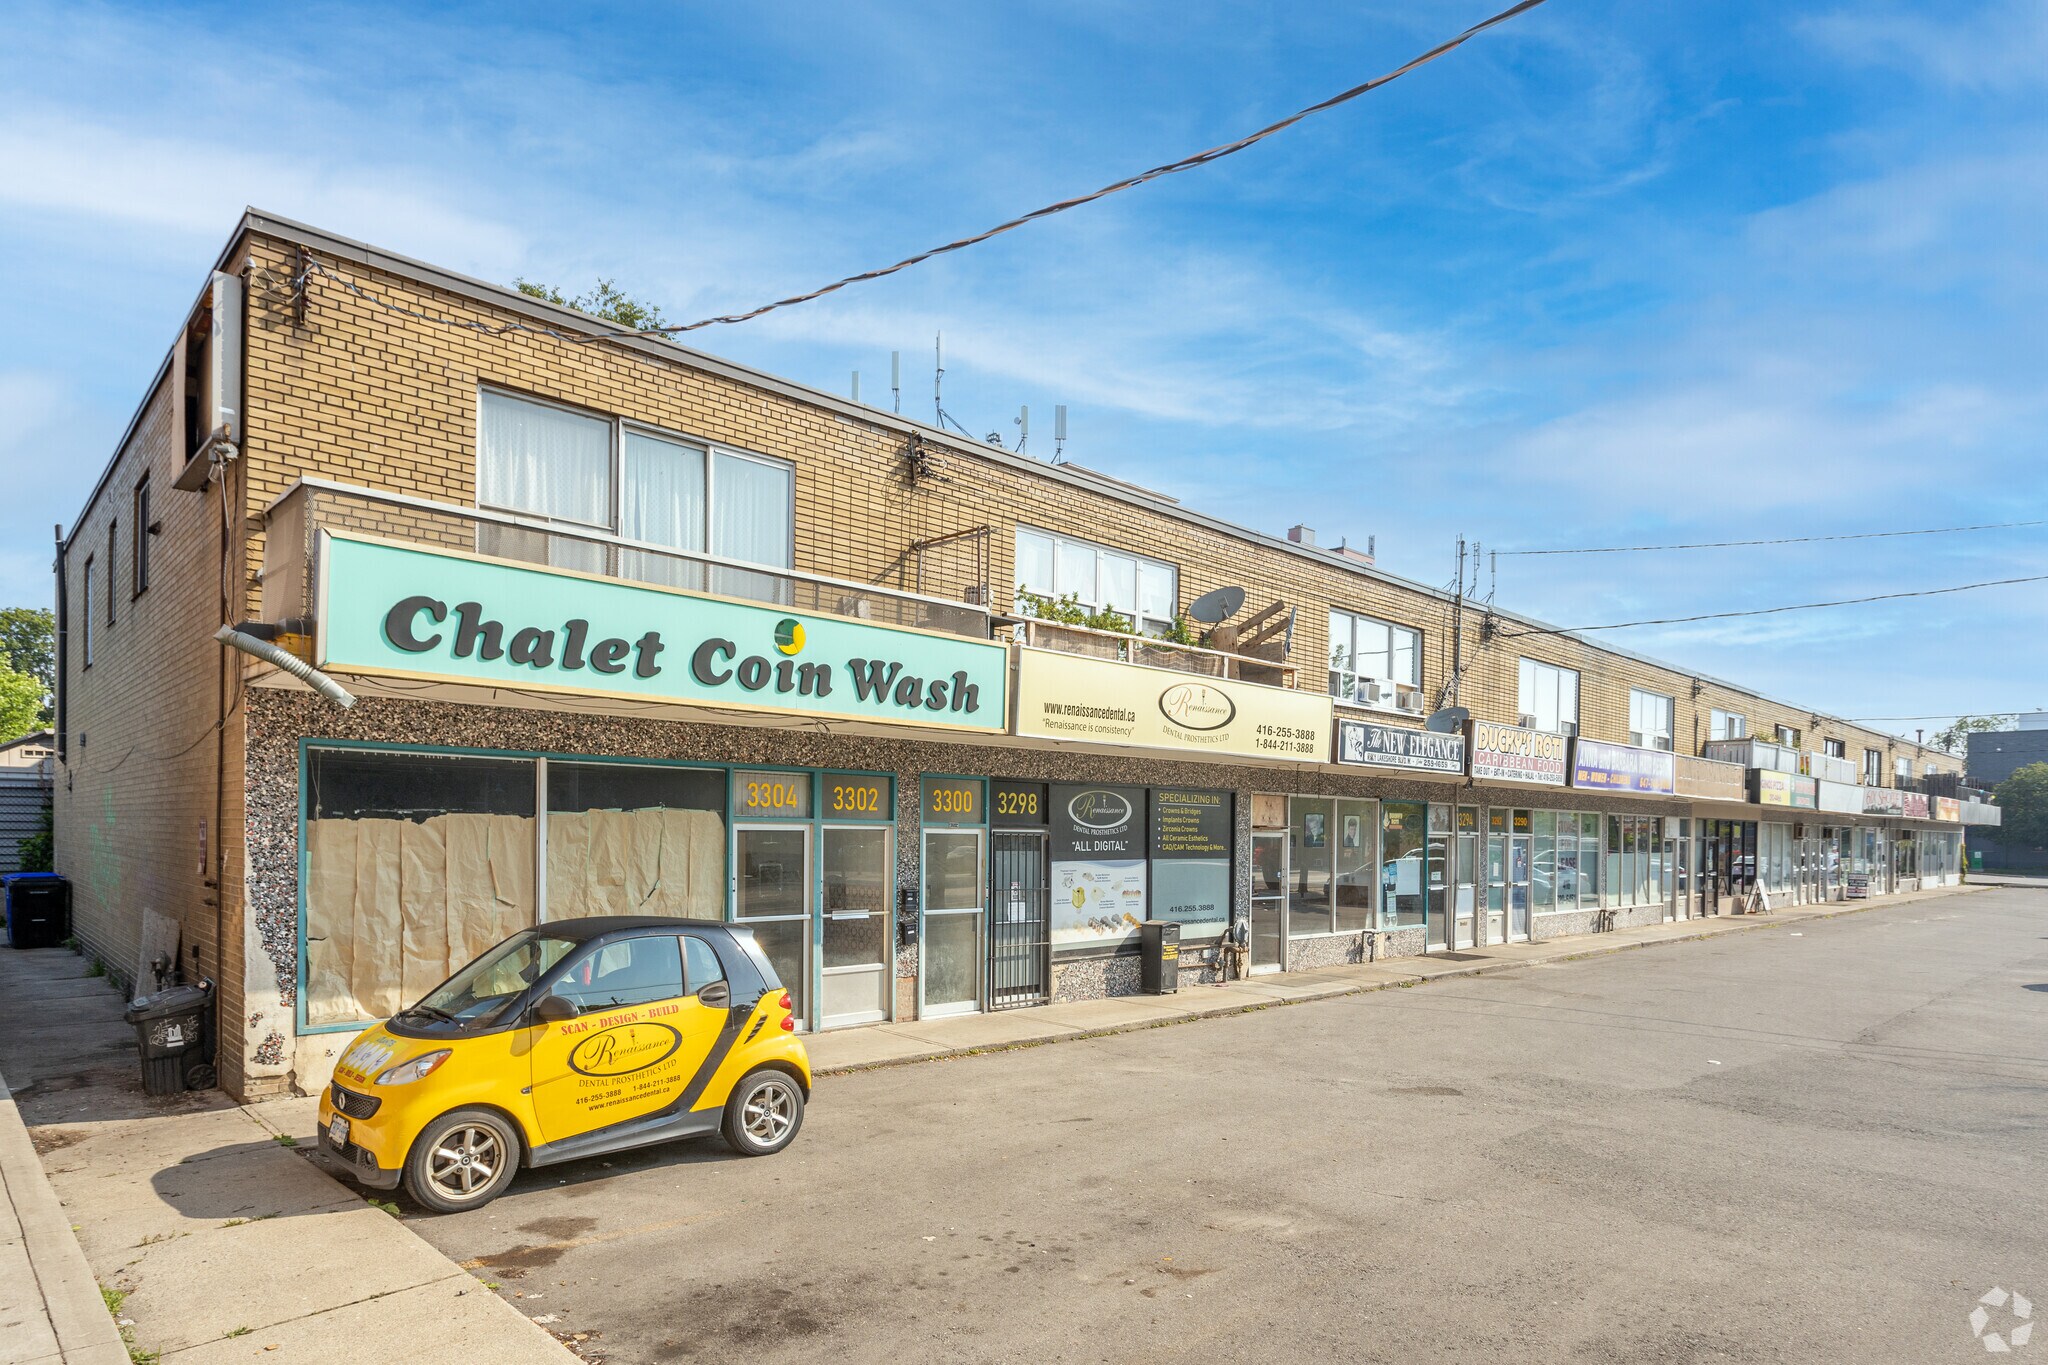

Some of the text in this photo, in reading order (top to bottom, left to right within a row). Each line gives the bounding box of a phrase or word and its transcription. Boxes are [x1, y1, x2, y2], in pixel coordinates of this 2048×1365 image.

[385, 596, 980, 715] Chalet Coin Wash
[1043, 702, 1136, 722] www.renaissancedental.ca
[1168, 686, 1228, 718] Renaissance
[1088, 723, 1094, 733] is
[1162, 725, 1230, 744] DENTAL PROSTHETICS LTD
[1256, 724, 1315, 741] 416-255-3888
[1255, 738, 1314, 754] 1-844-211-3888
[1382, 731, 1407, 755] NEW
[1409, 734, 1460, 761] ELEGANCE
[1477, 724, 1563, 761] DUCKY'S ROTI
[1478, 752, 1561, 773] CARIBBEAN FOOD
[747, 782, 798, 809] 3304
[833, 785, 879, 812] 3302
[933, 789, 973, 813] 3300
[998, 792, 1038, 815] 3298
[1076, 793, 1125, 819] Renaissance
[1159, 792, 1211, 804] SPECIALIZING
[1162, 816, 1182, 824] Implants
[1184, 808, 1202, 816] Bridges
[1514, 816, 1528, 827] 3290
[1073, 824, 1128, 836] DENTAL PROSTHETICS LTD
[1162, 834, 1209, 842] All Ceramic Esthetics
[1181, 825, 1199, 833] Crowns
[1162, 843, 1185, 851] CAD/CAM
[1185, 843, 1209, 852] Technology
[1169, 904, 1215, 913] 416.255.3888
[560, 1022, 589, 1036] SCAN
[600, 1011, 639, 1029] DESIGN
[648, 1004, 680, 1019] BUILD
[584, 1034, 672, 1071] Renaissance
[578, 1058, 677, 1088] DENTAL PROSTHETICS LTD
[575, 1074, 681, 1105] 416-255-3888 1-844-211-3888
[588, 1086, 671, 1111] www.renaissancedental.ca
